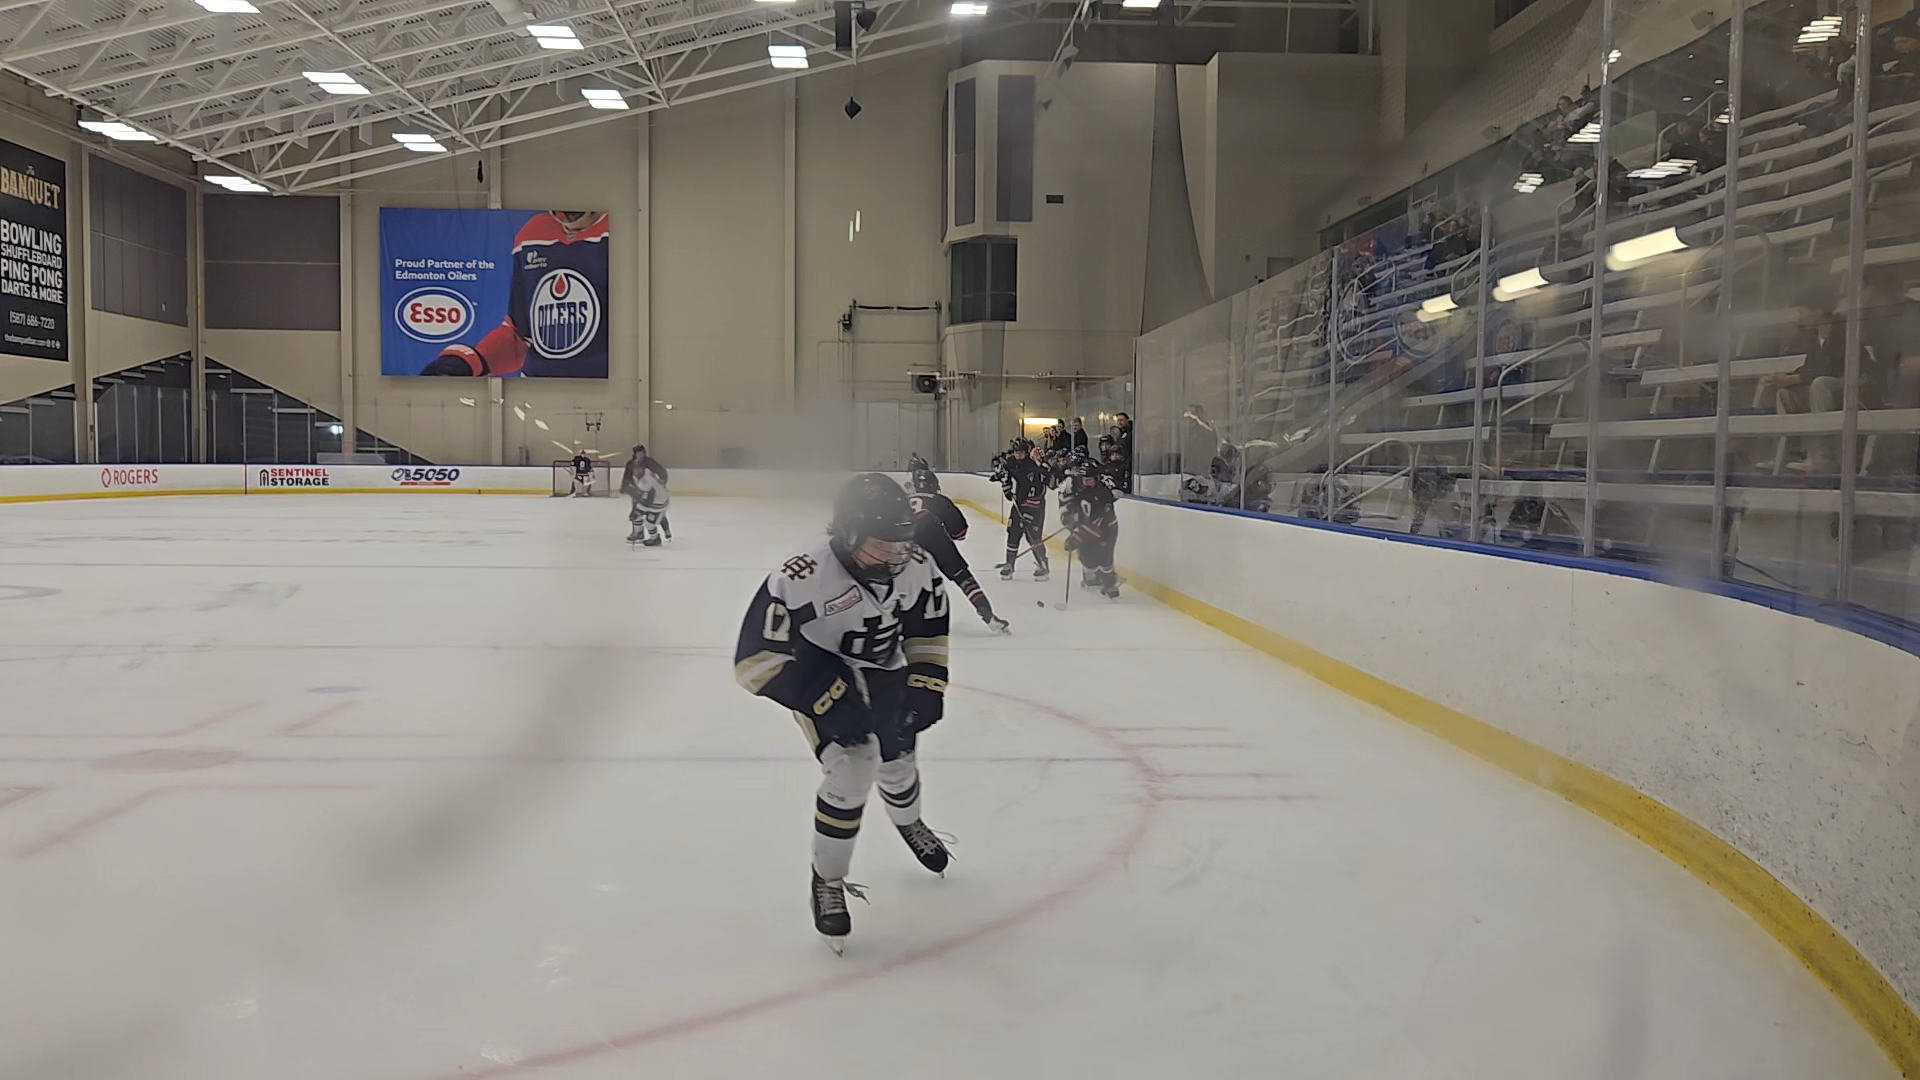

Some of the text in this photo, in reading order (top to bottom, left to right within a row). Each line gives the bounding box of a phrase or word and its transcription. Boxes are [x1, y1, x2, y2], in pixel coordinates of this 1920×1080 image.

[1, 166, 61, 209] BANQUET
[0, 218, 63, 255] BOWLING
[1, 243, 63, 269] SHUFFLEBOARD
[395, 258, 495, 270] Proud Partner of the
[1, 257, 63, 288] PING PONG
[395, 270, 477, 281] Edmonton Oilers
[1, 278, 64, 304] DARTS & MORE
[26, 314, 55, 330] 686-7220
[537, 300, 589, 334] OILERS
[113, 468, 159, 485] ROGERS
[270, 468, 330, 477] SENTINEL
[411, 468, 460, 482] 5050
[270, 477, 330, 487] STORAGE
